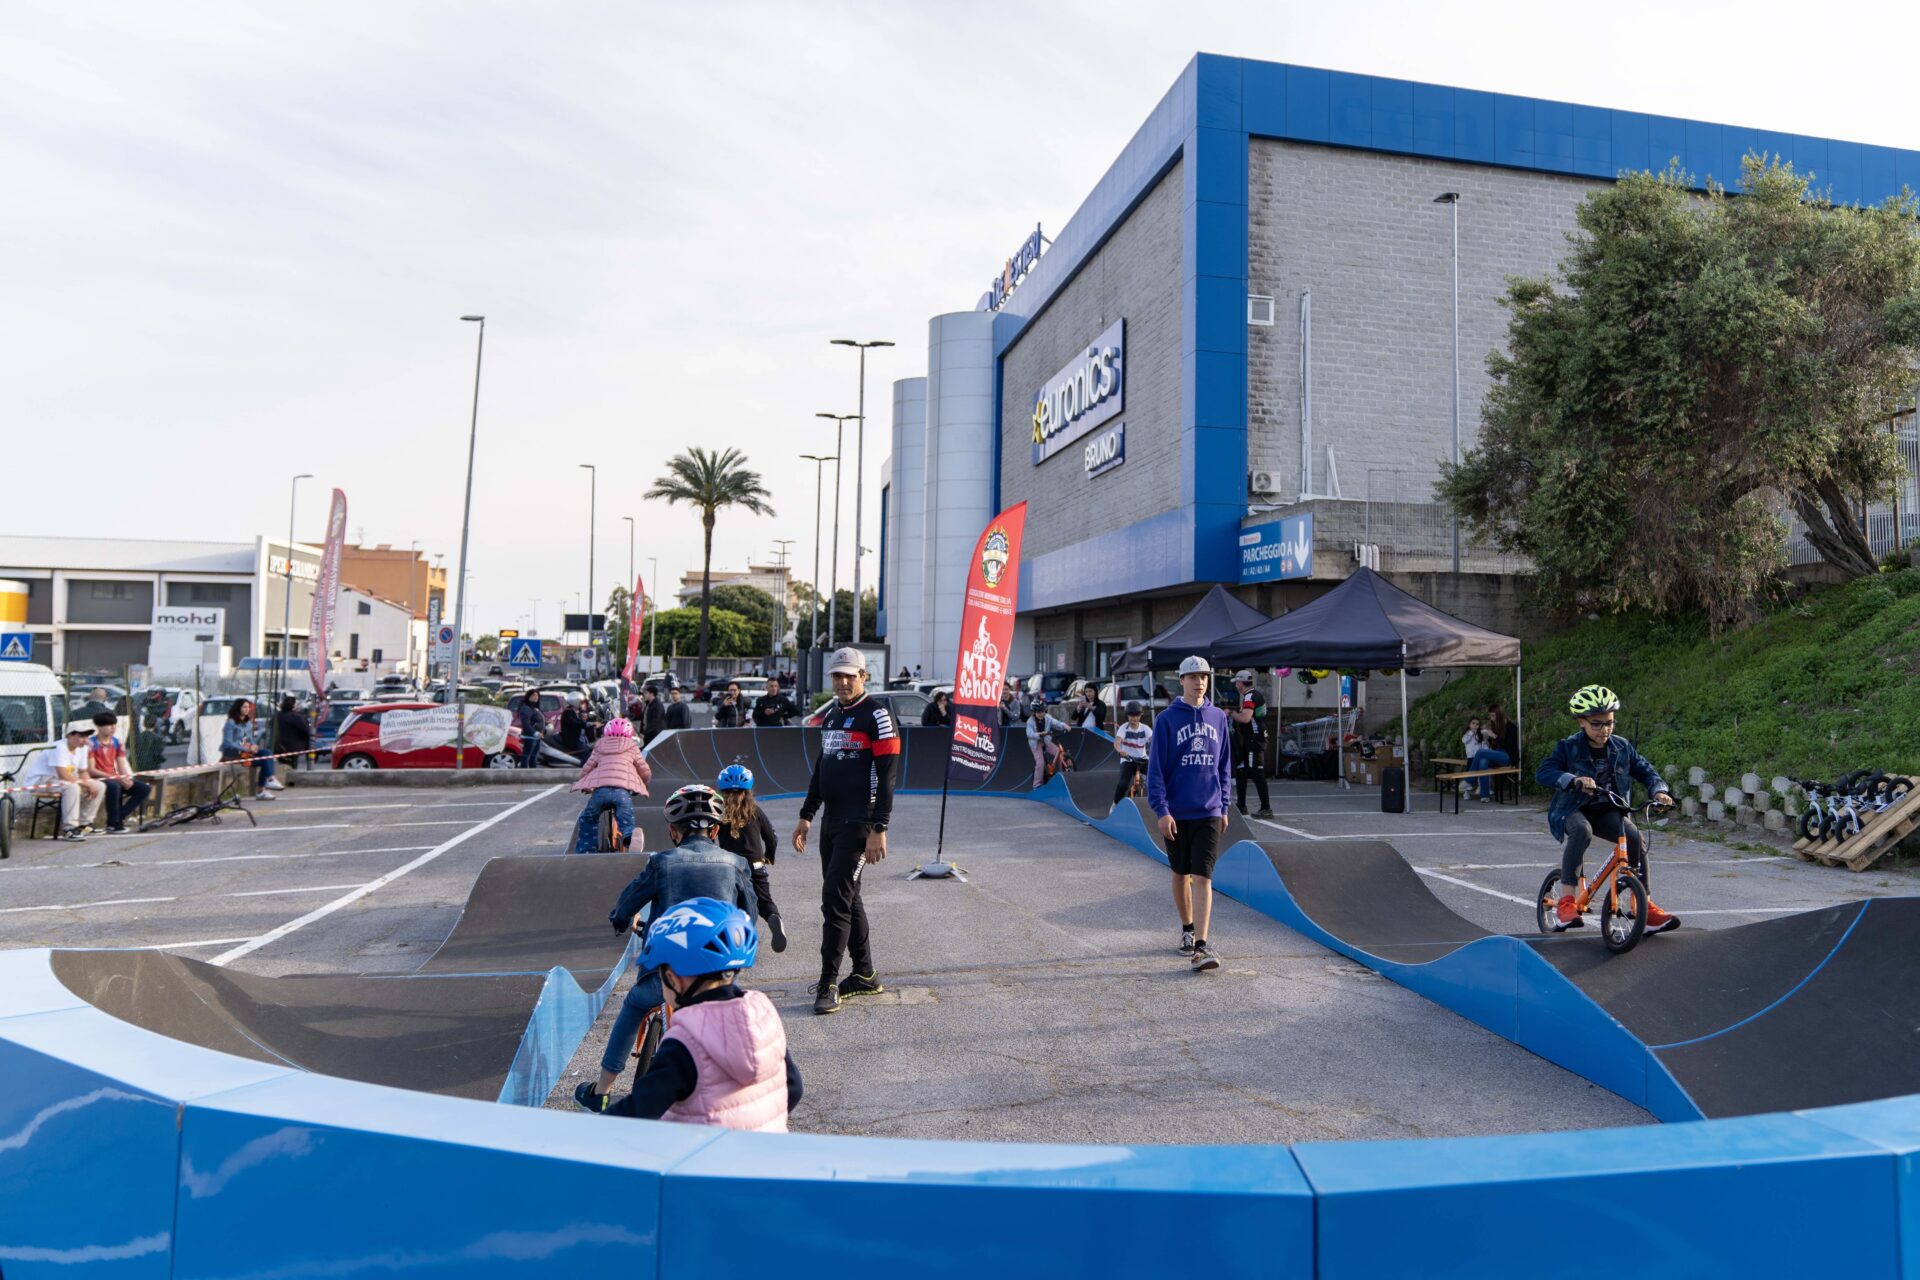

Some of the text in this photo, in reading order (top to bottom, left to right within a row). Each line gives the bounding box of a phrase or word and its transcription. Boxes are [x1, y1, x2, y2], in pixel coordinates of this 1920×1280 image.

[1040, 346, 1114, 439] euronics
[1085, 431, 1117, 471] BRUNO
[1243, 540, 1293, 564] PARCHEGGIO A
[157, 612, 217, 625] mohd
[963, 650, 1001, 682] MTB
[1177, 722, 1219, 746] ATLANTA
[1181, 754, 1214, 766] STATE
